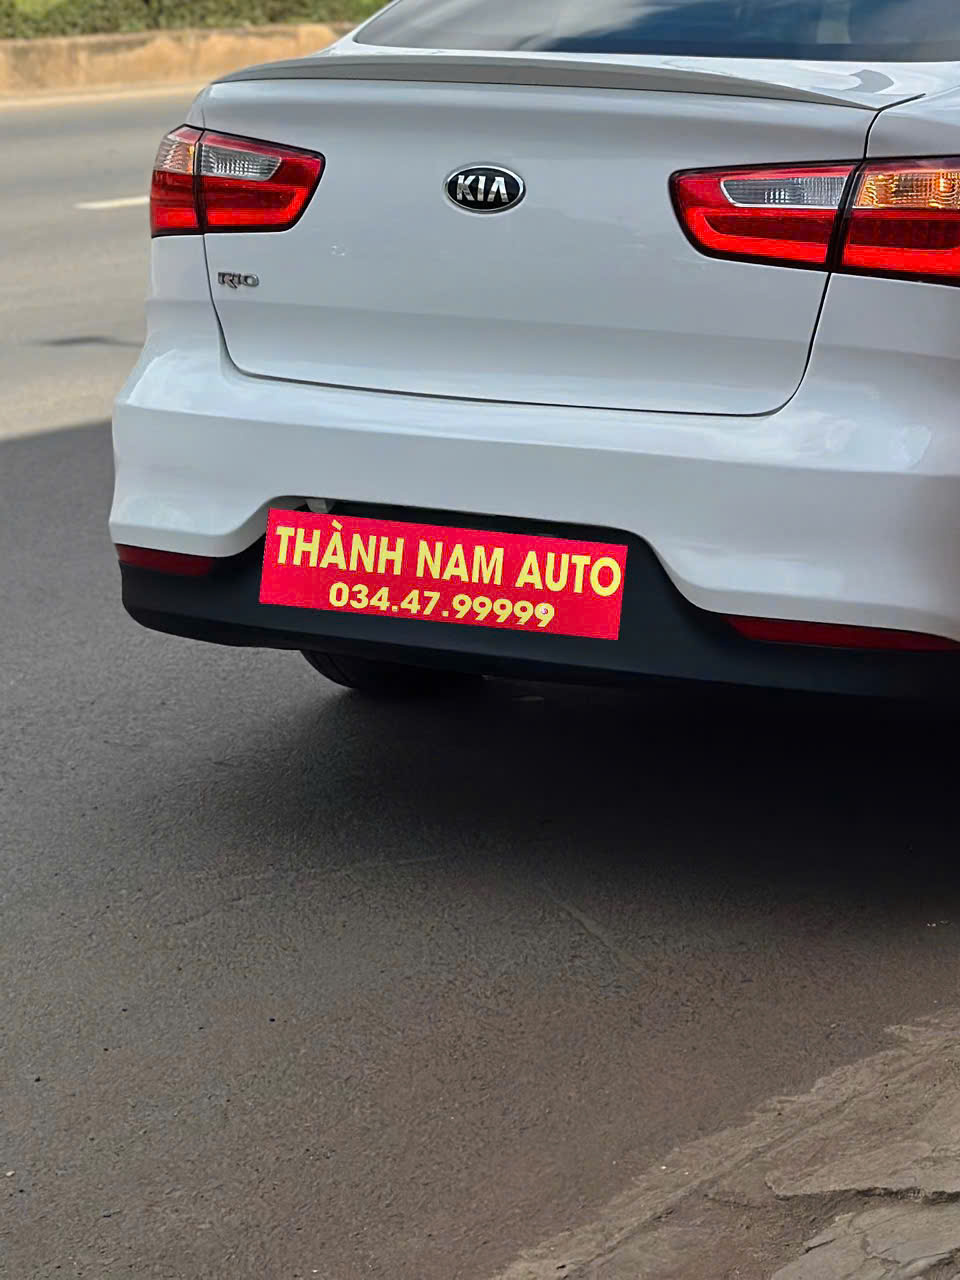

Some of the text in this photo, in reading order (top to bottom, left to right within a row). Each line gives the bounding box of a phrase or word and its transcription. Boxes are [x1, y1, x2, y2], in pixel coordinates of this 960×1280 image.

[456, 174, 510, 203] KIA
[217, 271, 260, 288] RIO
[275, 519, 622, 597] THÀNH NAM AUTO
[329, 581, 555, 628] 034.47.99999
